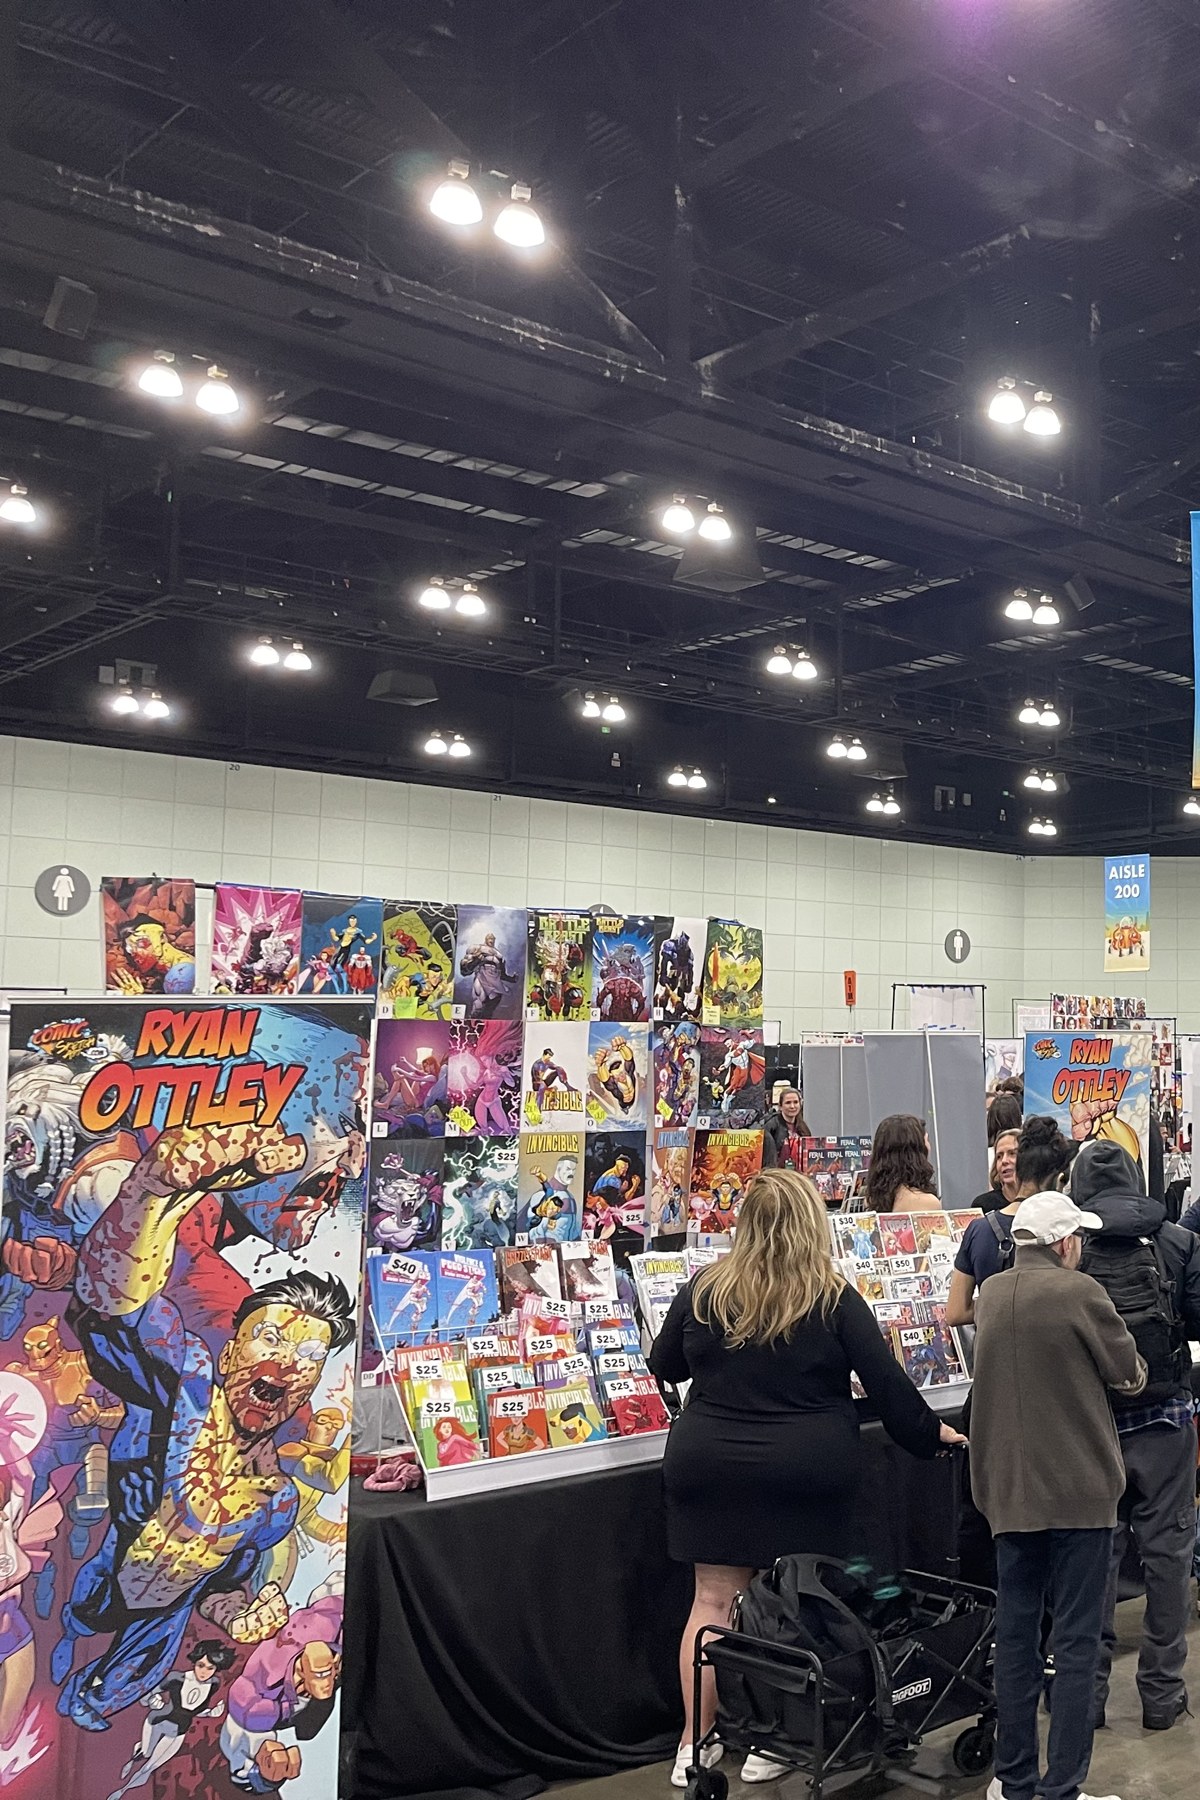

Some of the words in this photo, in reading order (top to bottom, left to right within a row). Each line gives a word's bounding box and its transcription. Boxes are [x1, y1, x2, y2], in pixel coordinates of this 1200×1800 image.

[1108, 863, 1145, 880] AISLE
[1114, 884, 1140, 899] 200
[382, 1006, 389, 1014] D
[455, 1006, 461, 1014] E
[530, 1009, 536, 1017] F
[591, 1010, 598, 1018] G
[31, 1021, 90, 1045] COMIC
[134, 1008, 262, 1059] RYAN
[1069, 1038, 1114, 1065] RYAN
[1052, 1068, 1132, 1105] OTTLEY
[79, 1061, 307, 1133] OTTLEY
[459, 1118, 473, 1128] OUT
[700, 1118, 707, 1127] Q
[377, 1124, 383, 1133] L
[448, 1124, 457, 1132] M
[526, 1134, 579, 1154] INVINCIBLE
[657, 1130, 690, 1149] INVINCIBLE
[707, 1133, 751, 1147] INVINCIBLE
[497, 1152, 516, 1162] $25
[809, 1151, 825, 1159] FERAL
[827, 1151, 844, 1159] FERAL
[844, 1150, 860, 1158] FERAL
[626, 1213, 641, 1222] $25
[838, 1217, 854, 1226] $30
[691, 1220, 698, 1229] Z
[517, 1235, 527, 1243] W
[933, 1253, 947, 1262] $75
[392, 1258, 417, 1274] $40
[645, 1260, 685, 1276] INVINCIBLE
[855, 1260, 871, 1270] $40
[895, 1259, 910, 1268] $50
[545, 1302, 566, 1313] $25
[589, 1304, 608, 1314] $25
[596, 1335, 616, 1344] $25
[903, 1331, 919, 1341] $40
[473, 1340, 494, 1350] $25
[531, 1339, 553, 1350] $25
[564, 1358, 584, 1371] $25
[604, 1358, 626, 1369] $25
[416, 1365, 439, 1375] $25
[487, 1371, 508, 1383] $25
[610, 1382, 630, 1391] $25
[426, 1402, 451, 1413] $25
[502, 1402, 524, 1412] $25
